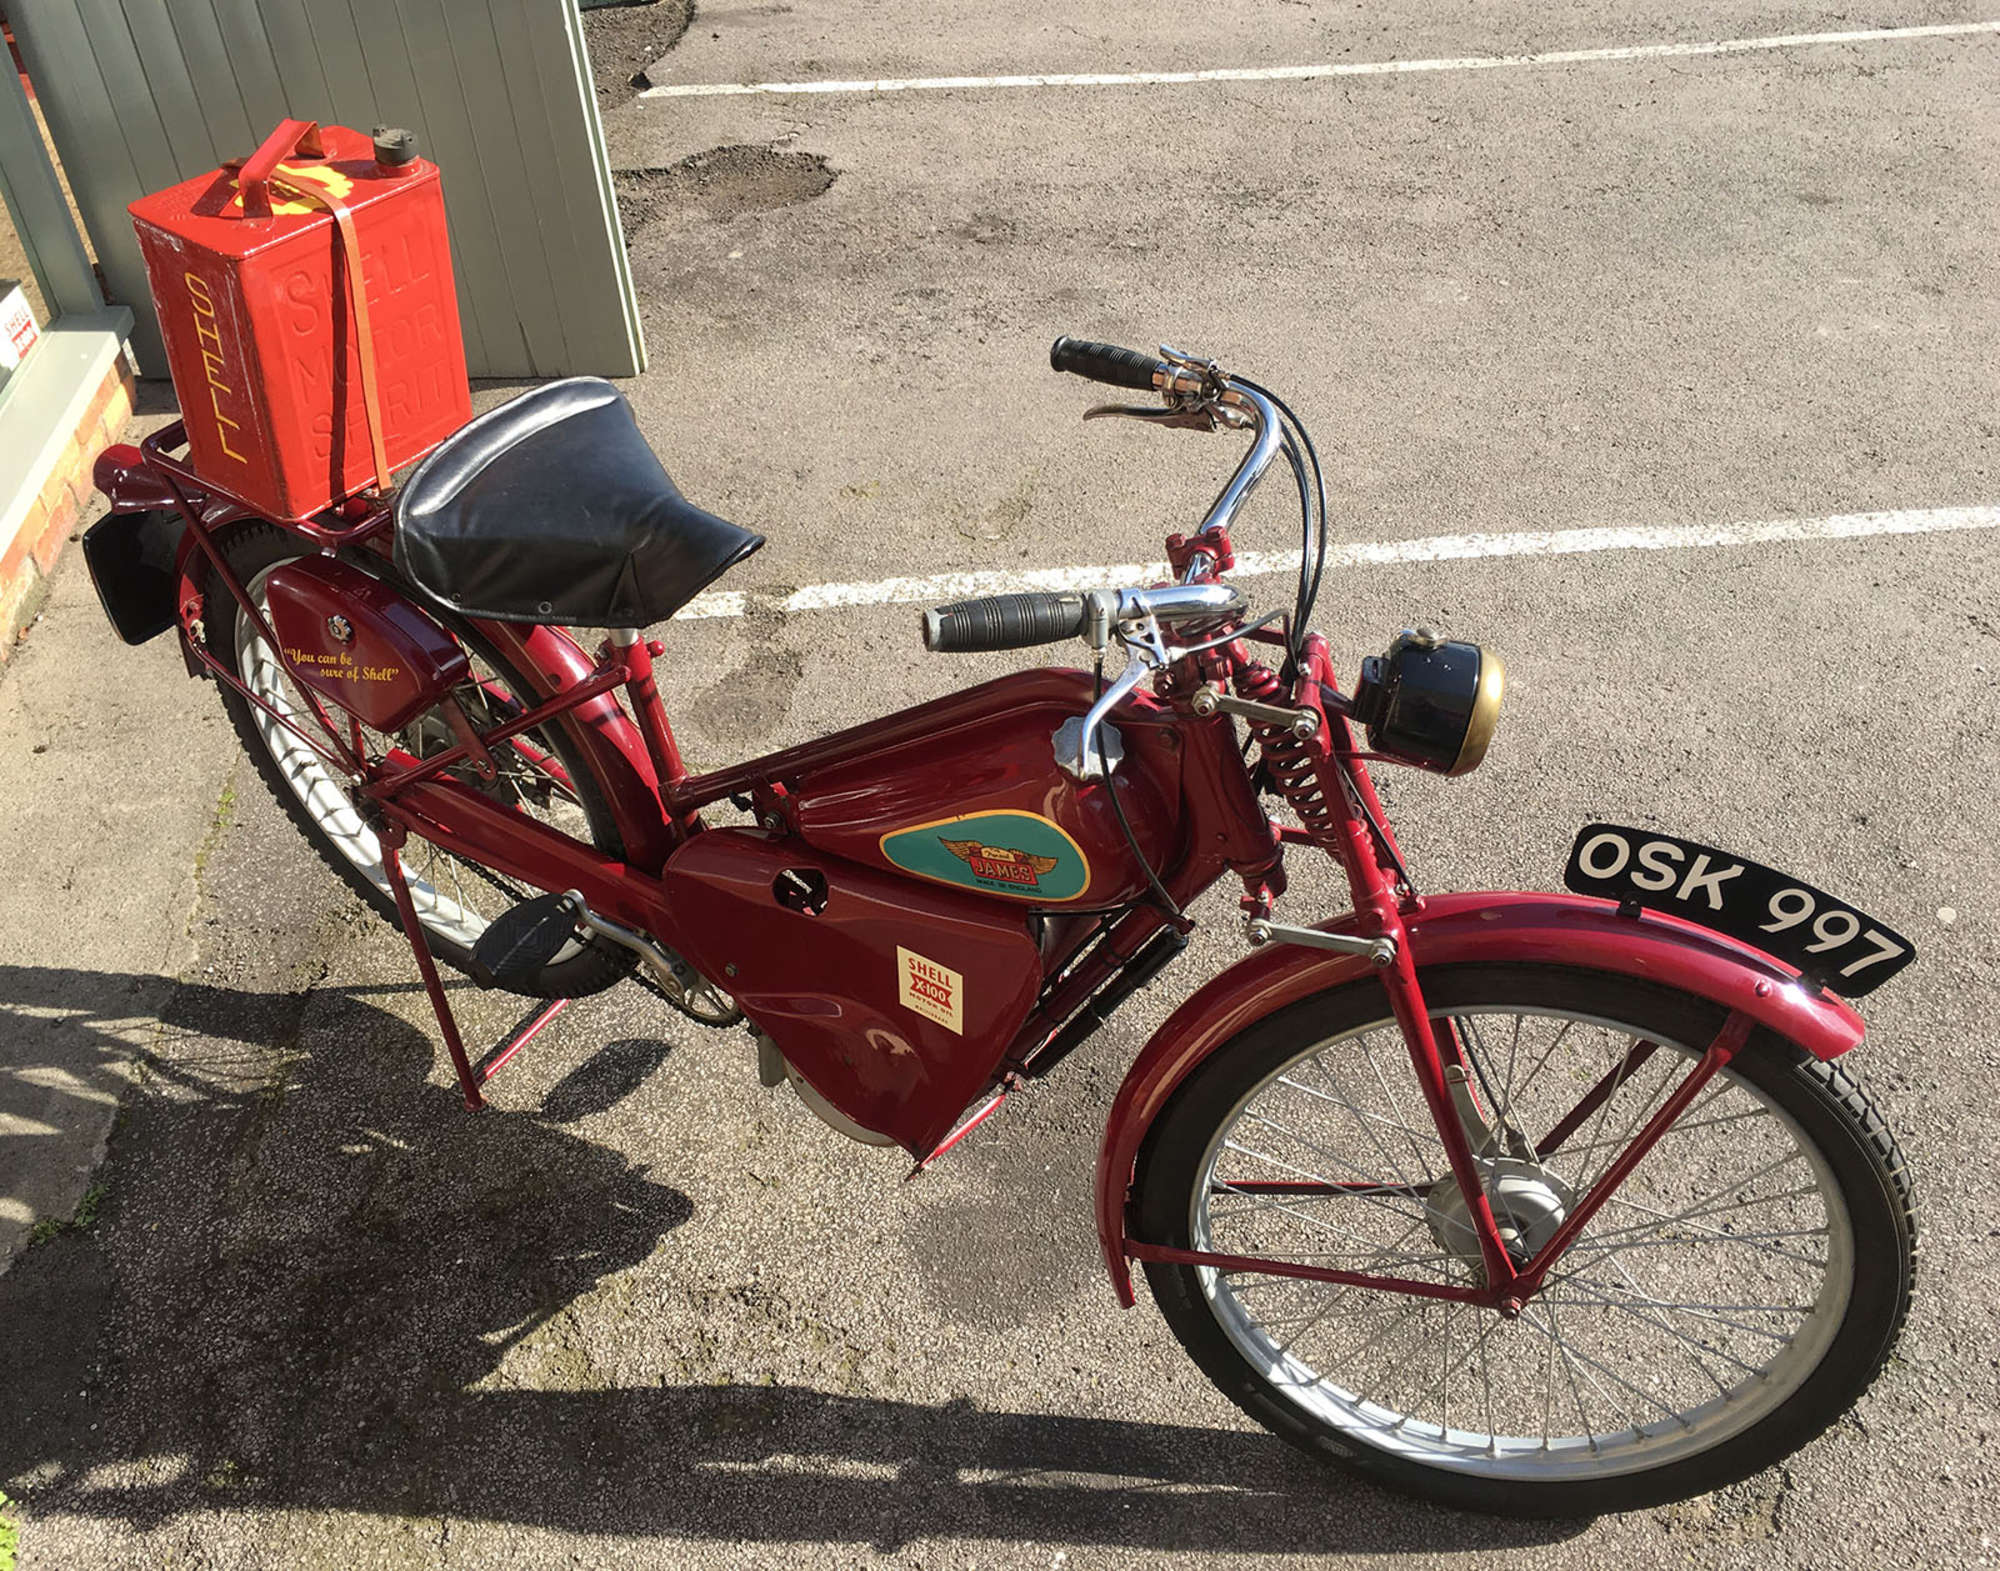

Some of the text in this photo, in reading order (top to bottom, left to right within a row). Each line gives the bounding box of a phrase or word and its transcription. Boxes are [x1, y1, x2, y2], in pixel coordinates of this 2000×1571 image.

[184, 272, 248, 464] SHELL
[313, 359, 446, 460] SPRIT
[318, 655, 337, 665] can
[340, 652, 352, 665] be
[320, 667, 343, 679] sure
[346, 666, 359, 683] of
[975, 861, 1031, 881] JAMES
[1579, 833, 1906, 978] OSK 997
[908, 957, 953, 988] SHELL
[914, 977, 946, 1002] X-100
